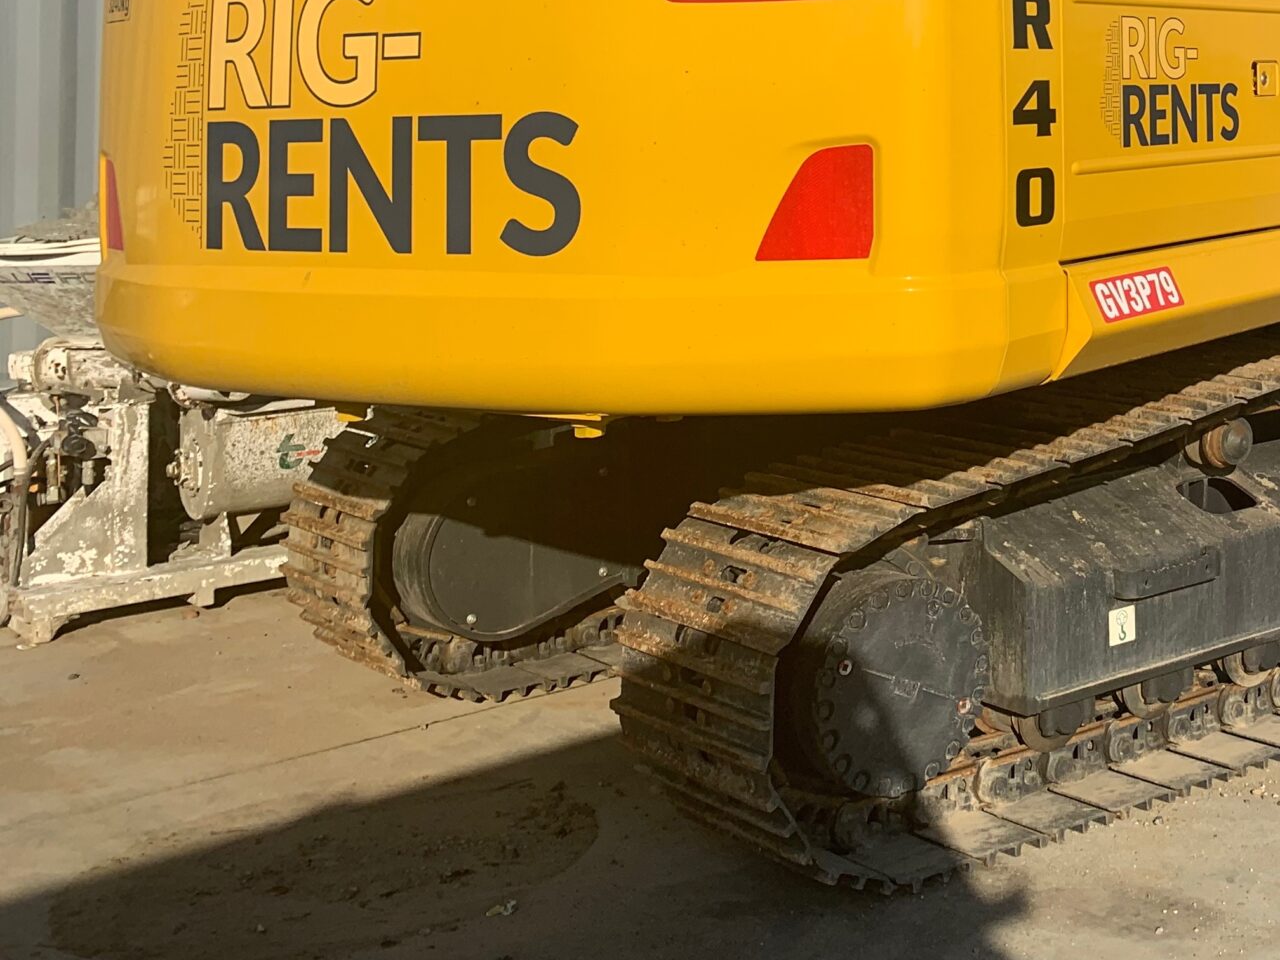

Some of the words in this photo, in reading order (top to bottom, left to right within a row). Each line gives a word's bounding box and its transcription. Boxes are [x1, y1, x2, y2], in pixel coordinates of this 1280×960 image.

[1120, 15, 1199, 80] RIG-
[1122, 82, 1240, 148] RENTS
[206, 111, 582, 257] RENTS
[1094, 271, 1180, 319] GV3P79
